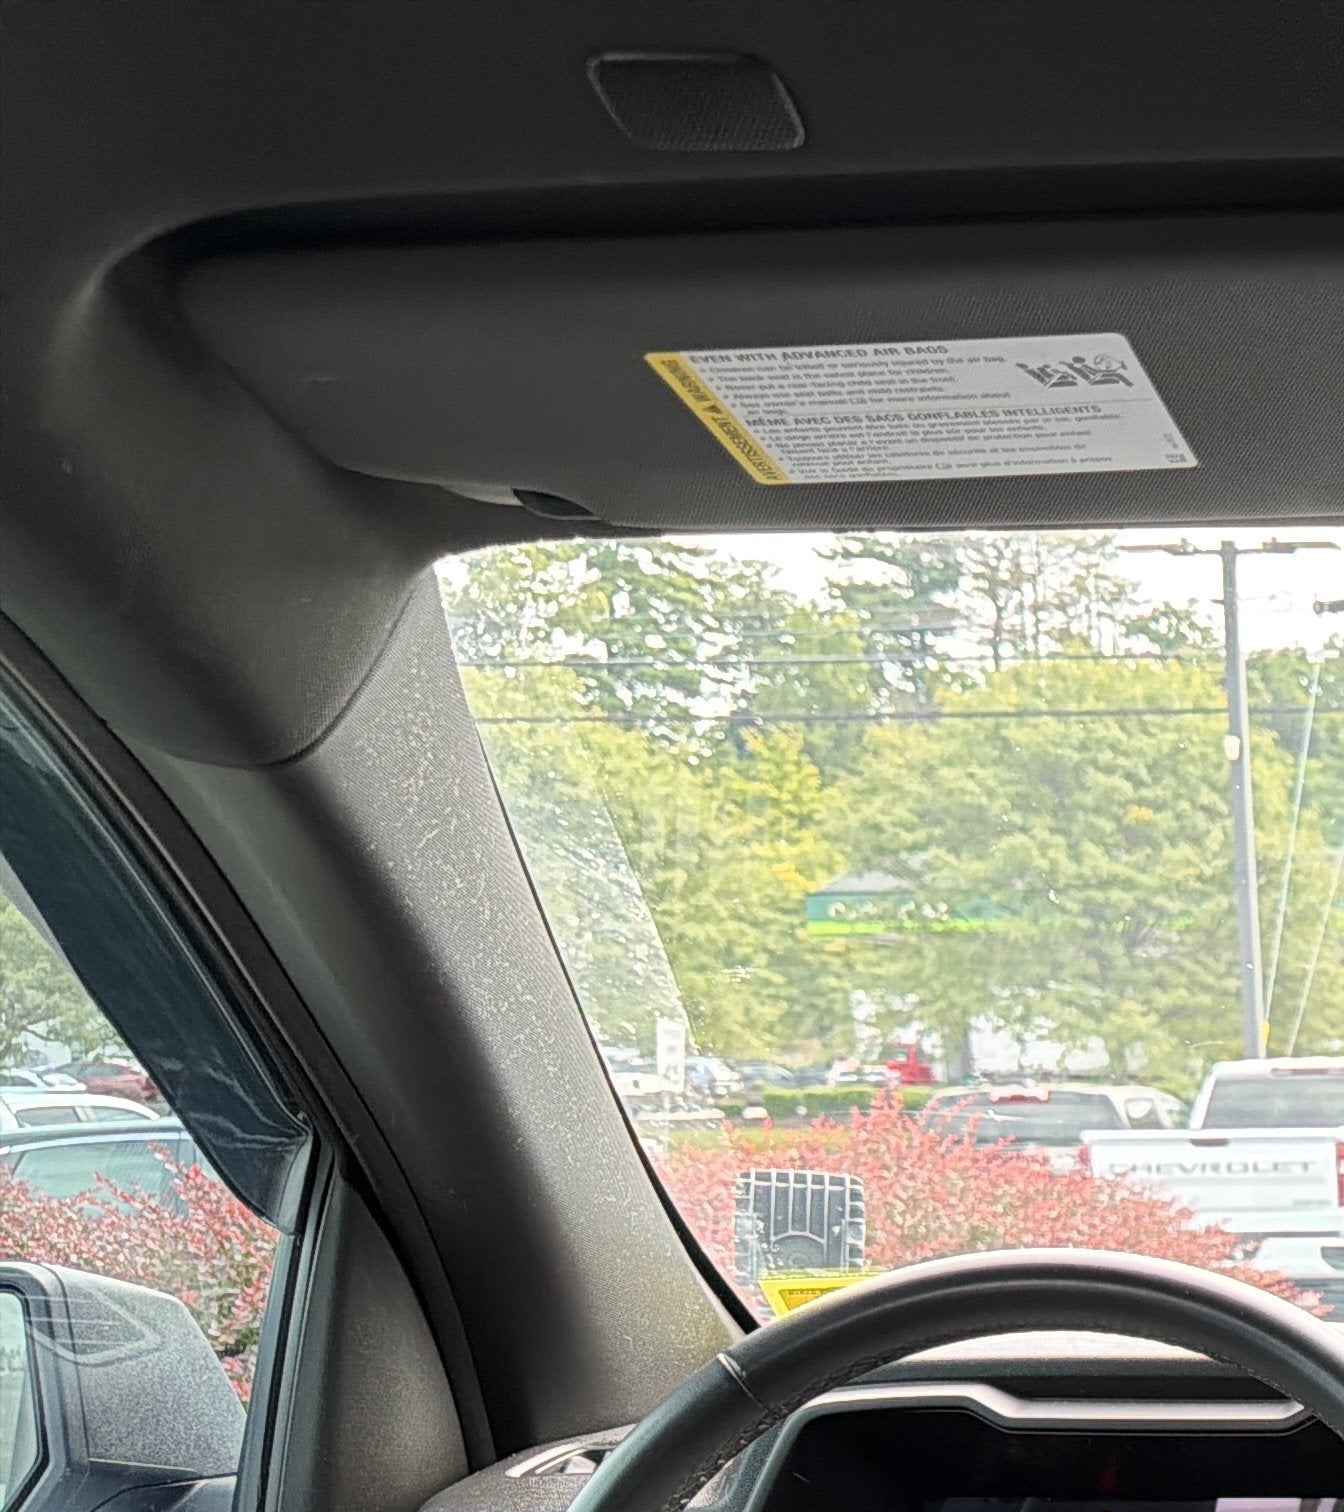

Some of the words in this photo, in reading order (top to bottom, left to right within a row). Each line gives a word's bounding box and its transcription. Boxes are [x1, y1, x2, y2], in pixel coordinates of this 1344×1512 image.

[690, 354, 731, 365] EVEN
[737, 352, 777, 363] WITH
[783, 348, 868, 362] ADVANCED
[874, 347, 901, 357] AIR
[905, 345, 949, 355] BAGS
[793, 415, 830, 426] AVEC
[834, 414, 863, 424] DES
[867, 413, 902, 423] SACS
[906, 409, 997, 421] GONFLABLES
[1003, 405, 1102, 417] INTELLIGENTS
[1108, 1160, 1316, 1175] CHEVROLET
